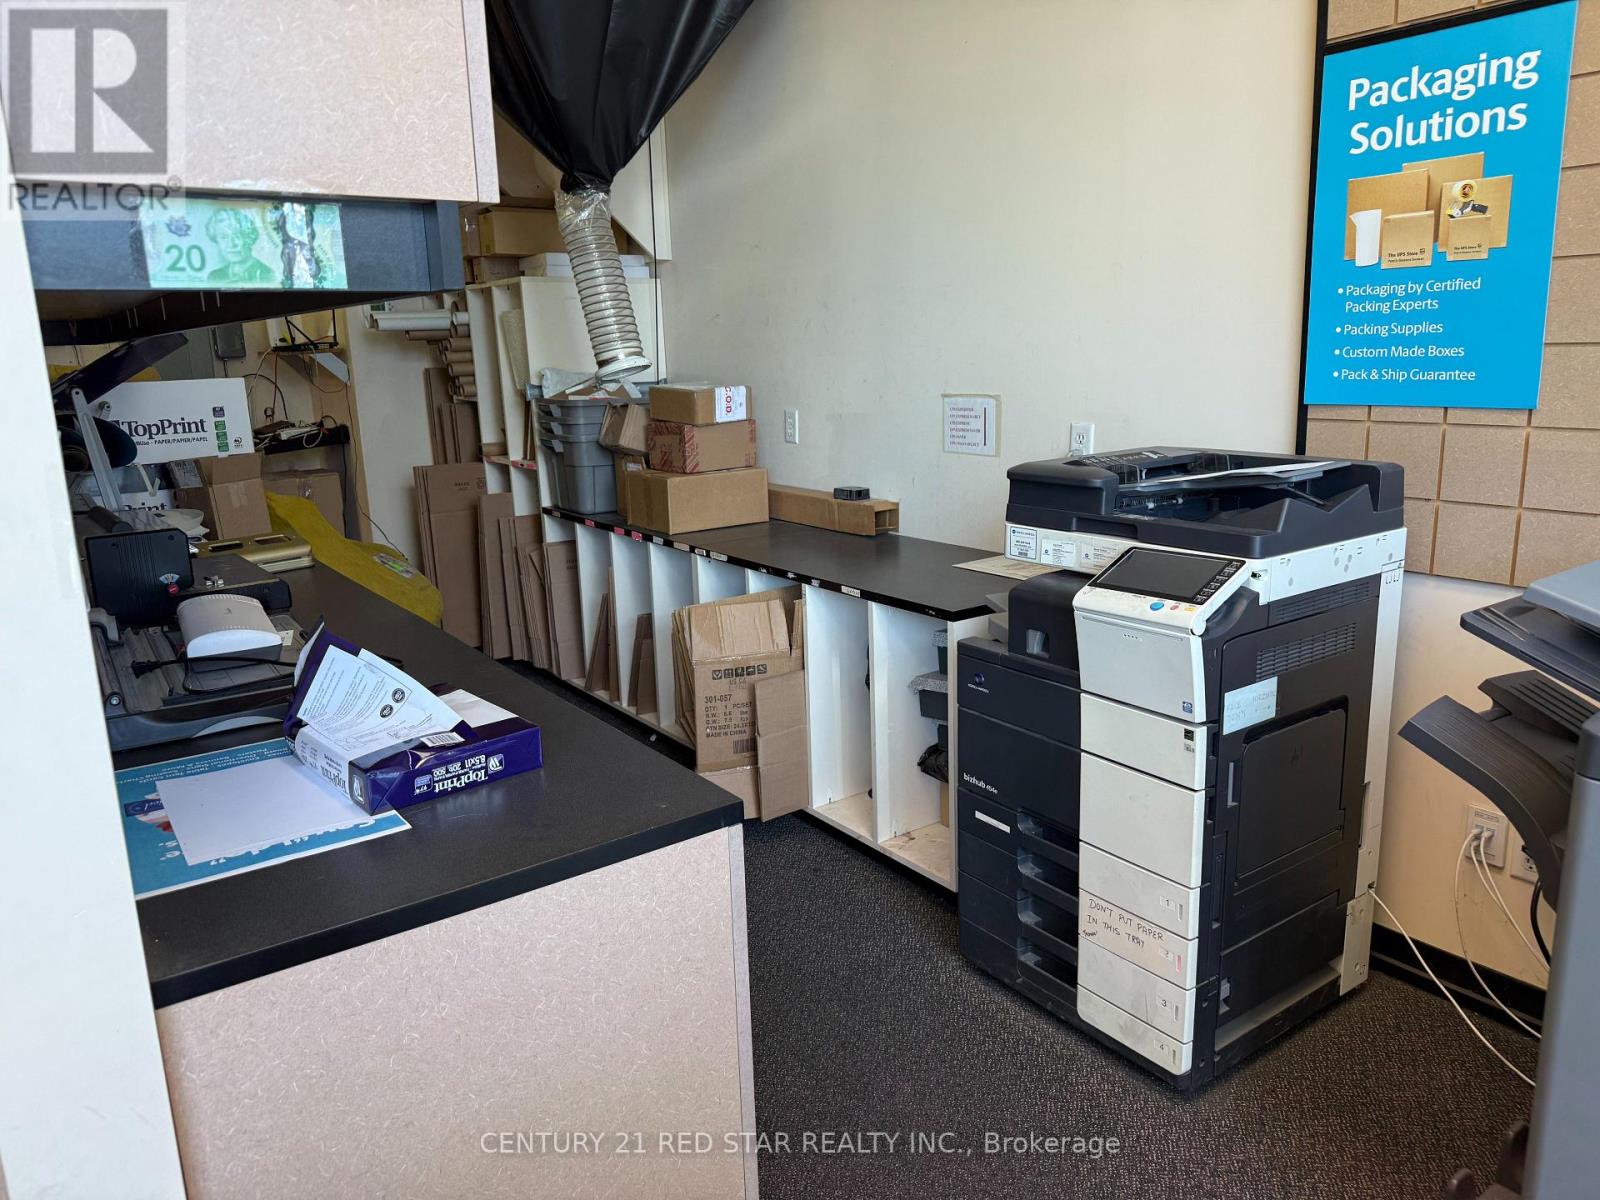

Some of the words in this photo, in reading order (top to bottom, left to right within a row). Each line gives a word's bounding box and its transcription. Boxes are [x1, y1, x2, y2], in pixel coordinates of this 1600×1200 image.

[1348, 50, 1542, 111] Packaging
[1349, 103, 1528, 155] Solutions
[165, 244, 206, 273] 20
[1346, 283, 1406, 297] Packaging
[1408, 281, 1422, 294] by
[1426, 277, 1481, 292] Certified
[1345, 300, 1390, 313] Packing
[1392, 298, 1439, 312] Experts
[1344, 323, 1388, 336] Packing
[1391, 321, 1443, 335] Supplies
[1342, 346, 1388, 358] Custom
[1390, 345, 1425, 357] Made
[1428, 345, 1465, 357] Boxes
[1341, 369, 1368, 380] Pack
[1370, 369, 1379, 379] &
[1381, 369, 1408, 382] Ship
[1410, 369, 1476, 381] Guarantee
[122, 417, 208, 440] TopPrint
[704, 693, 733, 704] 301-057
[465, 754, 486, 768] 8.5x11
[433, 767, 446, 777] 500
[434, 769, 488, 793] TopPrint
[963, 771, 986, 789] bizhub
[1089, 898, 1114, 918] DON'T
[1118, 913, 1133, 927] PUT
[1137, 923, 1164, 941] PAPER
[1087, 914, 1098, 925] IN
[1103, 921, 1121, 936] THIS
[1125, 932, 1145, 948] TRAY
[1161, 999, 1167, 1007] 3
